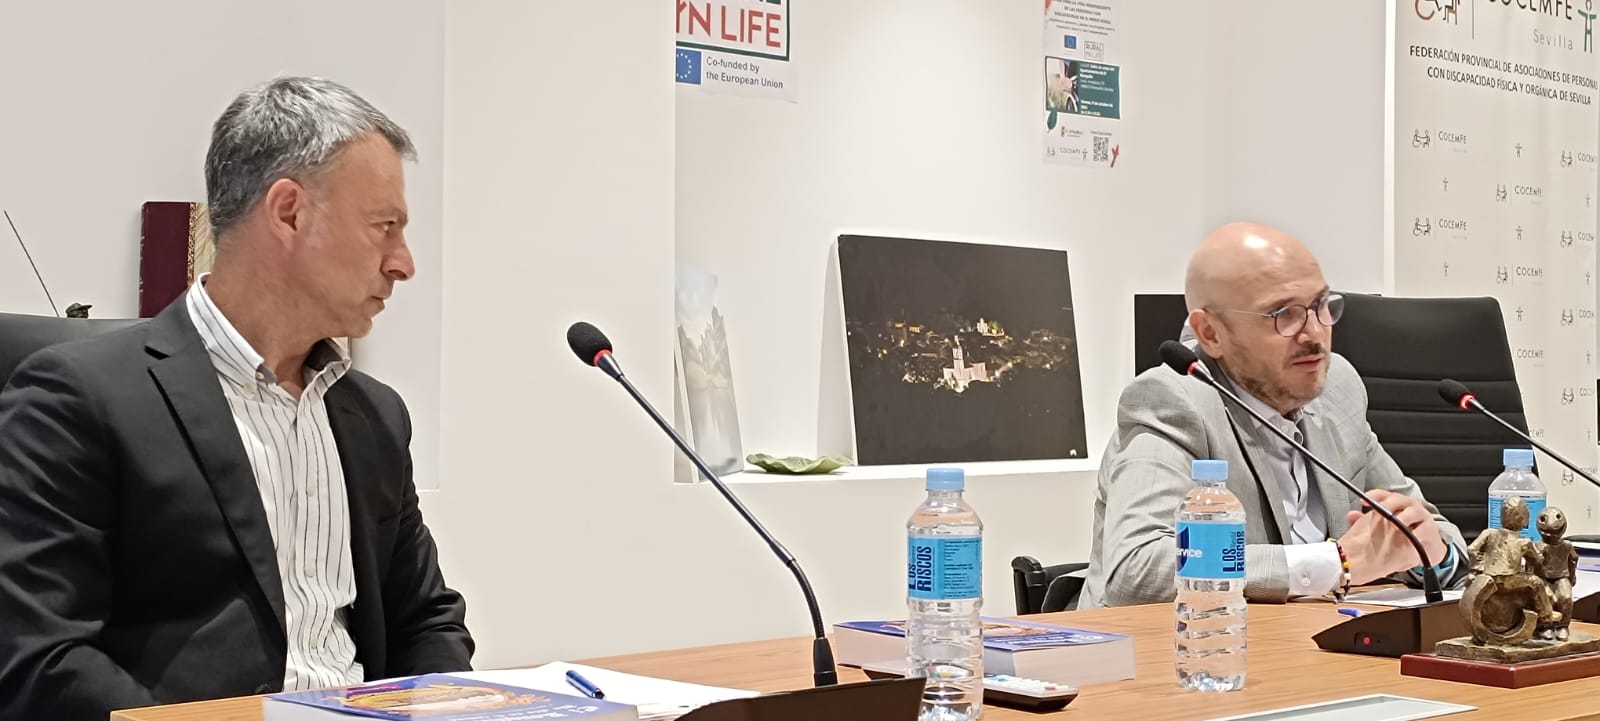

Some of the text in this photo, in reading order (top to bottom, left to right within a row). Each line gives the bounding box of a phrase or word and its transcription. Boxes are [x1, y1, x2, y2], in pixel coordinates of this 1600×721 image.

[721, 5, 781, 48] LIFE
[1533, 28, 1573, 50] Sevilla
[706, 56, 760, 74] Co-funded by
[1410, 45, 1460, 63] FEDERACIÓN
[1461, 53, 1502, 71] PROVINCIAL
[1503, 61, 1512, 73] DE
[1514, 63, 1561, 82] ASOCIACIONES
[1562, 72, 1571, 84] DE
[706, 71, 784, 89] the European Union
[1427, 66, 1445, 79] CON
[1446, 69, 1496, 88] DISCAPACIDAD
[1497, 77, 1518, 93] FÍSICA
[1519, 82, 1525, 93] Y
[1559, 90, 1569, 101] DE
[1569, 91, 1592, 105] SEVILLA
[1438, 130, 1467, 144] COCEMFE
[1438, 218, 1467, 231] COCEMFE
[916, 546, 932, 592] RISCOS
[1222, 548, 1237, 573] LOS
